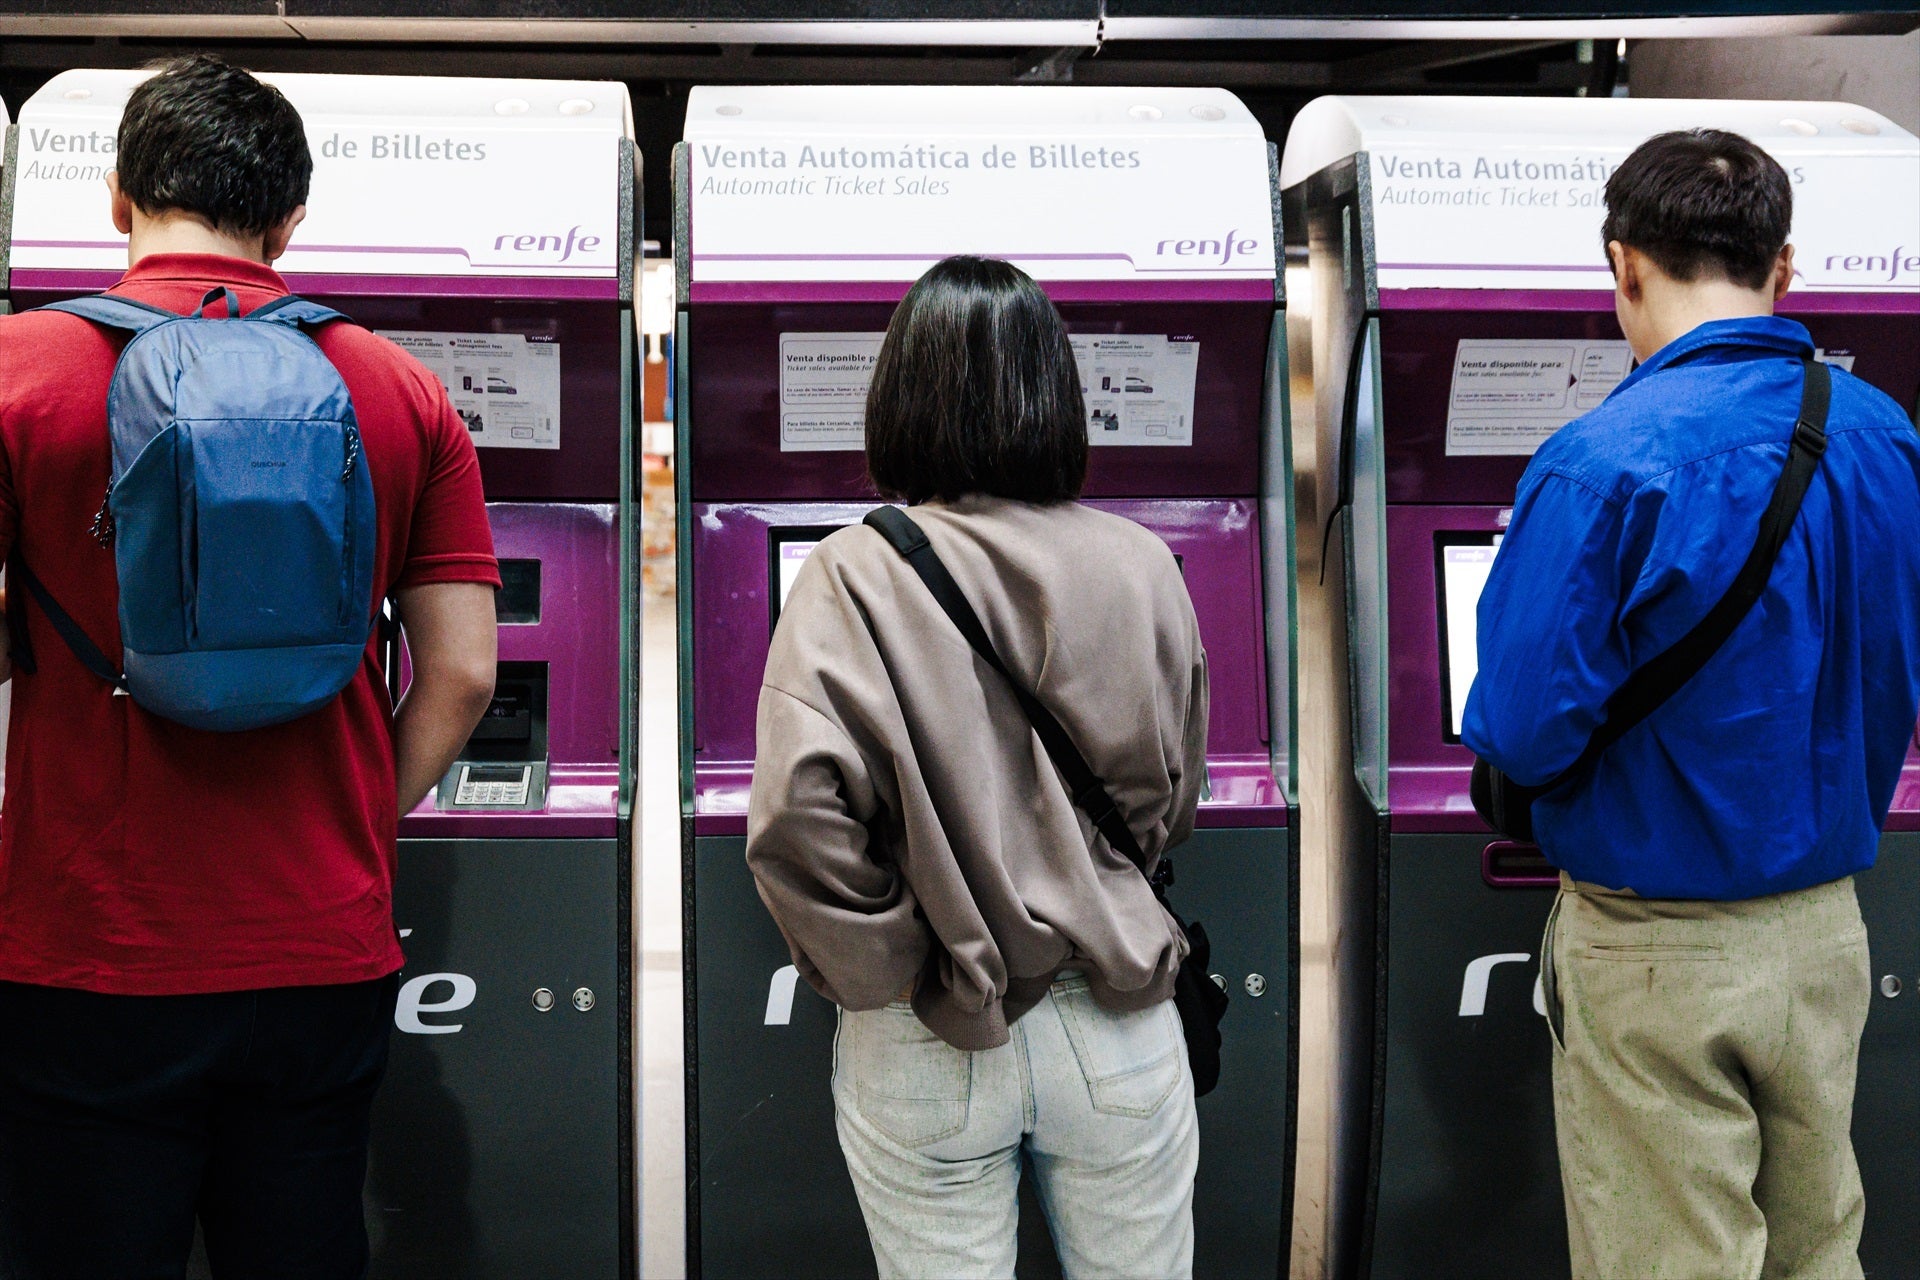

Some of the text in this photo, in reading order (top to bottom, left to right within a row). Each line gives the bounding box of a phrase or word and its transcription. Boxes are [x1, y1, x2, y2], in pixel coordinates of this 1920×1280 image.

[29, 128, 486, 161] Venta de Billetes
[701, 143, 1141, 169] Venta Automática de Billetes
[1379, 155, 1462, 179] Venta
[700, 175, 950, 196] Automatic Ticket Sales
[1379, 185, 1602, 208] Automatic Ticket Sal
[493, 224, 601, 263] renfe
[1156, 228, 1259, 266] renfe
[1825, 245, 1920, 282] renfe
[786, 354, 814, 362] Venta
[816, 353, 867, 364] disponible
[1460, 360, 1488, 369] Venta
[1490, 359, 1539, 370] disponible
